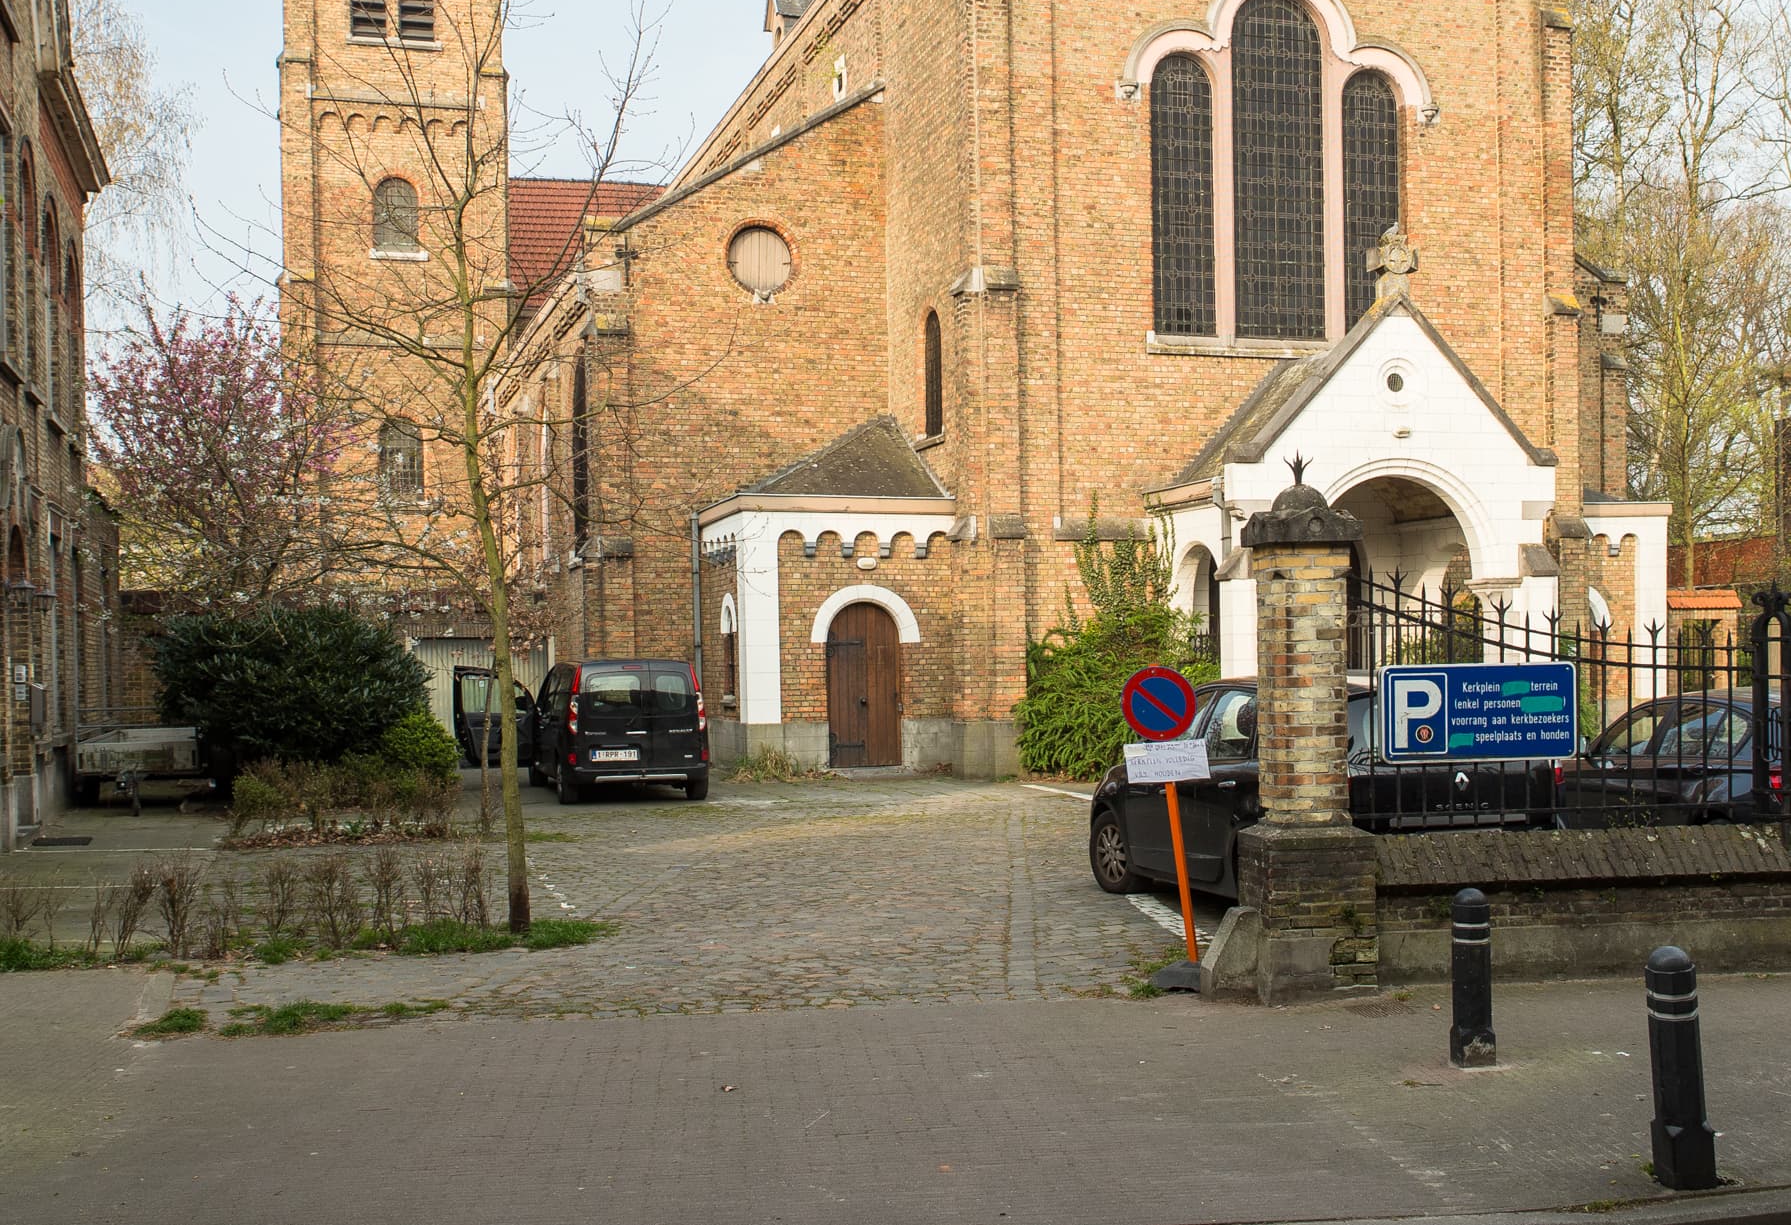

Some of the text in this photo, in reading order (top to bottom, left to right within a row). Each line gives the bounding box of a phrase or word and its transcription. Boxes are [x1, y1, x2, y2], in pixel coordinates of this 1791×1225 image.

[1462, 680, 1558, 695] Kerkplein terrein
[1454, 698, 1480, 710] (enkel
[1483, 699, 1521, 712] personen
[1394, 679, 1442, 748] P
[1451, 713, 1570, 728] voorrang aan kerkbezoekers
[1475, 728, 1570, 744] speelplaats en honden
